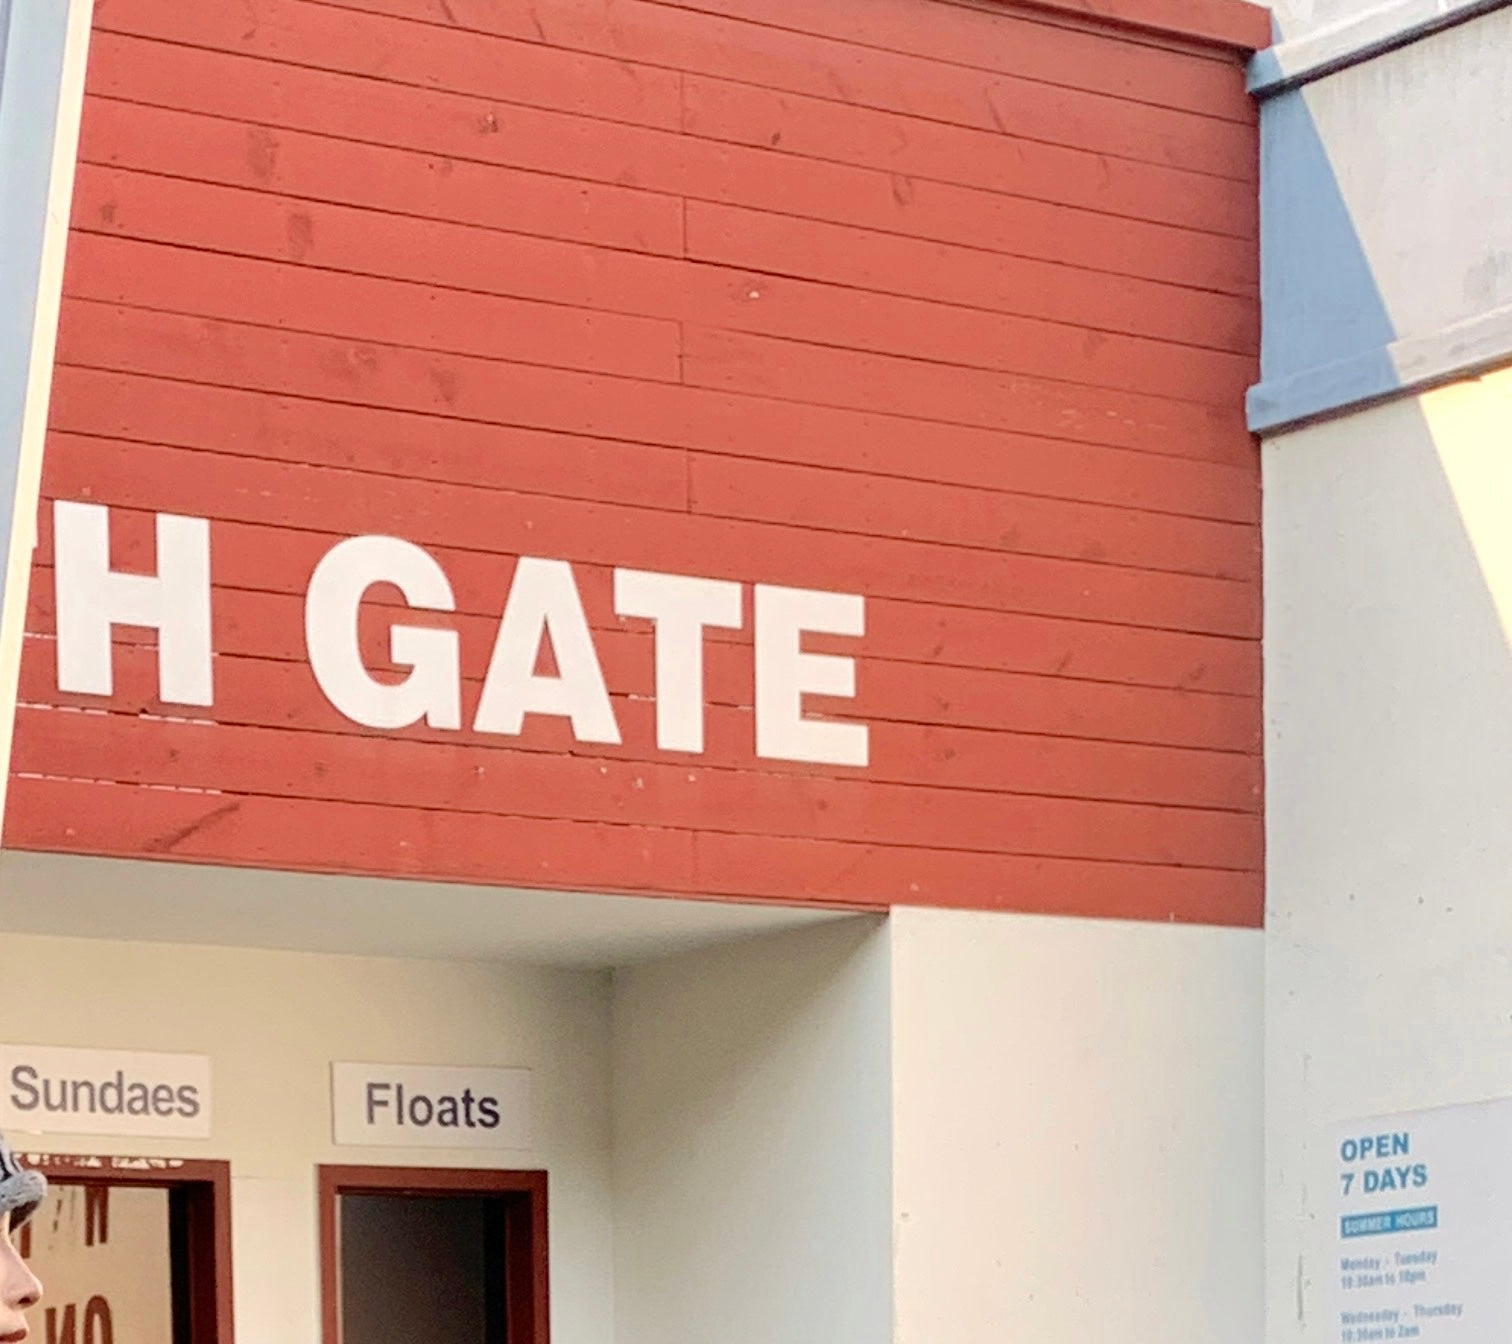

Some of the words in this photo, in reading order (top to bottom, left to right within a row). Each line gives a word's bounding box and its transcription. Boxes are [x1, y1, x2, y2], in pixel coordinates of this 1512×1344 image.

[304, 534, 870, 767] GATE
[9, 1065, 201, 1118] Sundaes
[365, 1082, 501, 1129] Floats
[1340, 1132, 1410, 1162] OPEN
[1340, 1172, 1355, 1196] 7
[1363, 1164, 1428, 1193] DAYS
[1344, 1215, 1391, 1235] SUMMER
[1395, 1210, 1435, 1228] HOURS
[1340, 1256, 1381, 1272] Monday
[1394, 1250, 1438, 1266] Tuesday
[1340, 1308, 1400, 1325] Wednesday
[1413, 1302, 1464, 1318] Thursday
